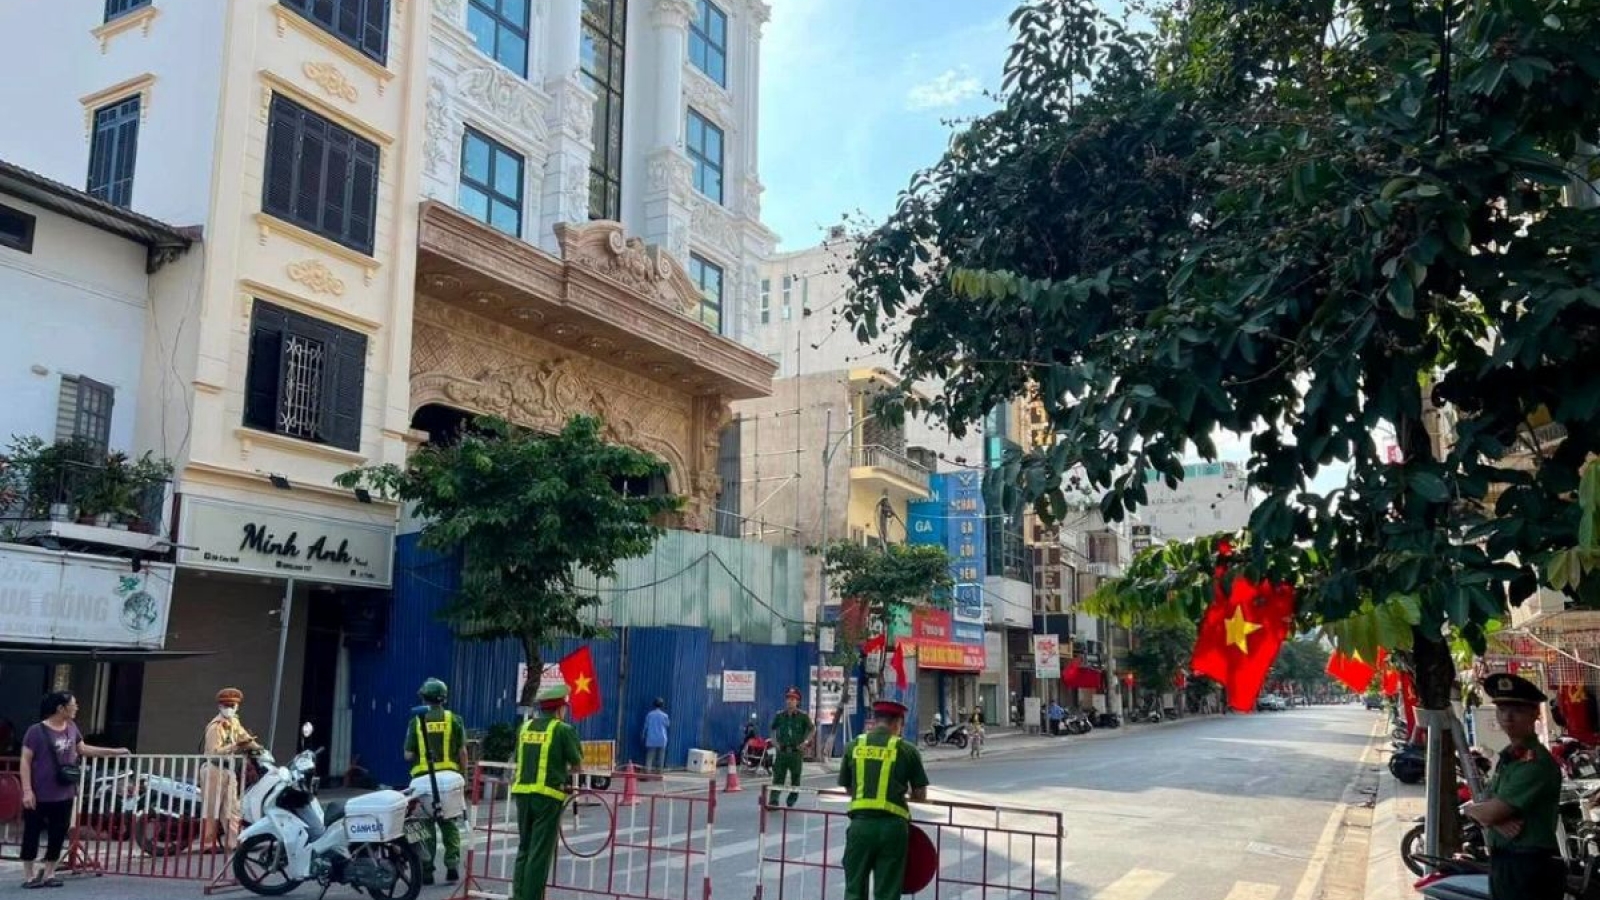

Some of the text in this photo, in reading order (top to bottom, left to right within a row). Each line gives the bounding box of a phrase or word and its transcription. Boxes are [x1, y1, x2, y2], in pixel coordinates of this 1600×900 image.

[914, 521, 933, 532] GA
[240, 522, 300, 557] Minh
[306, 535, 353, 564] Anh
